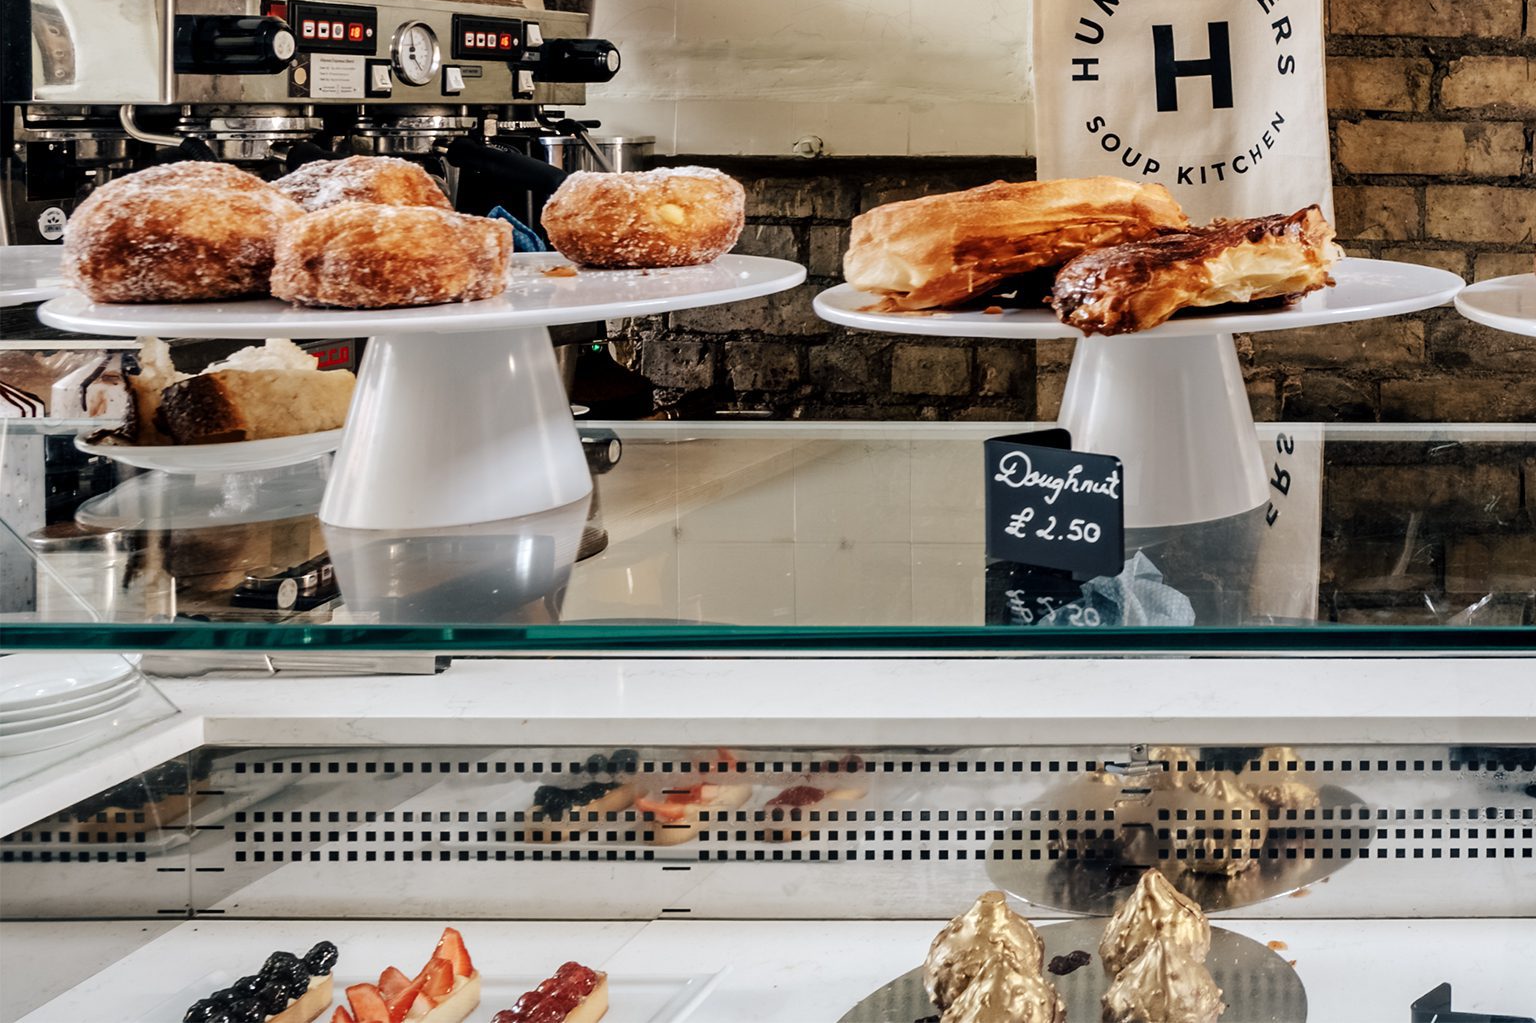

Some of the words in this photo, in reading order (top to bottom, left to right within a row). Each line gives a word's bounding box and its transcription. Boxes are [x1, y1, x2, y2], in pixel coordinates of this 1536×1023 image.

[1152, 21, 1233, 112] H
[1086, 115, 1160, 176] SOUP
[1177, 111, 1285, 185] KITCHEN
[994, 450, 1121, 504] Doughnut
